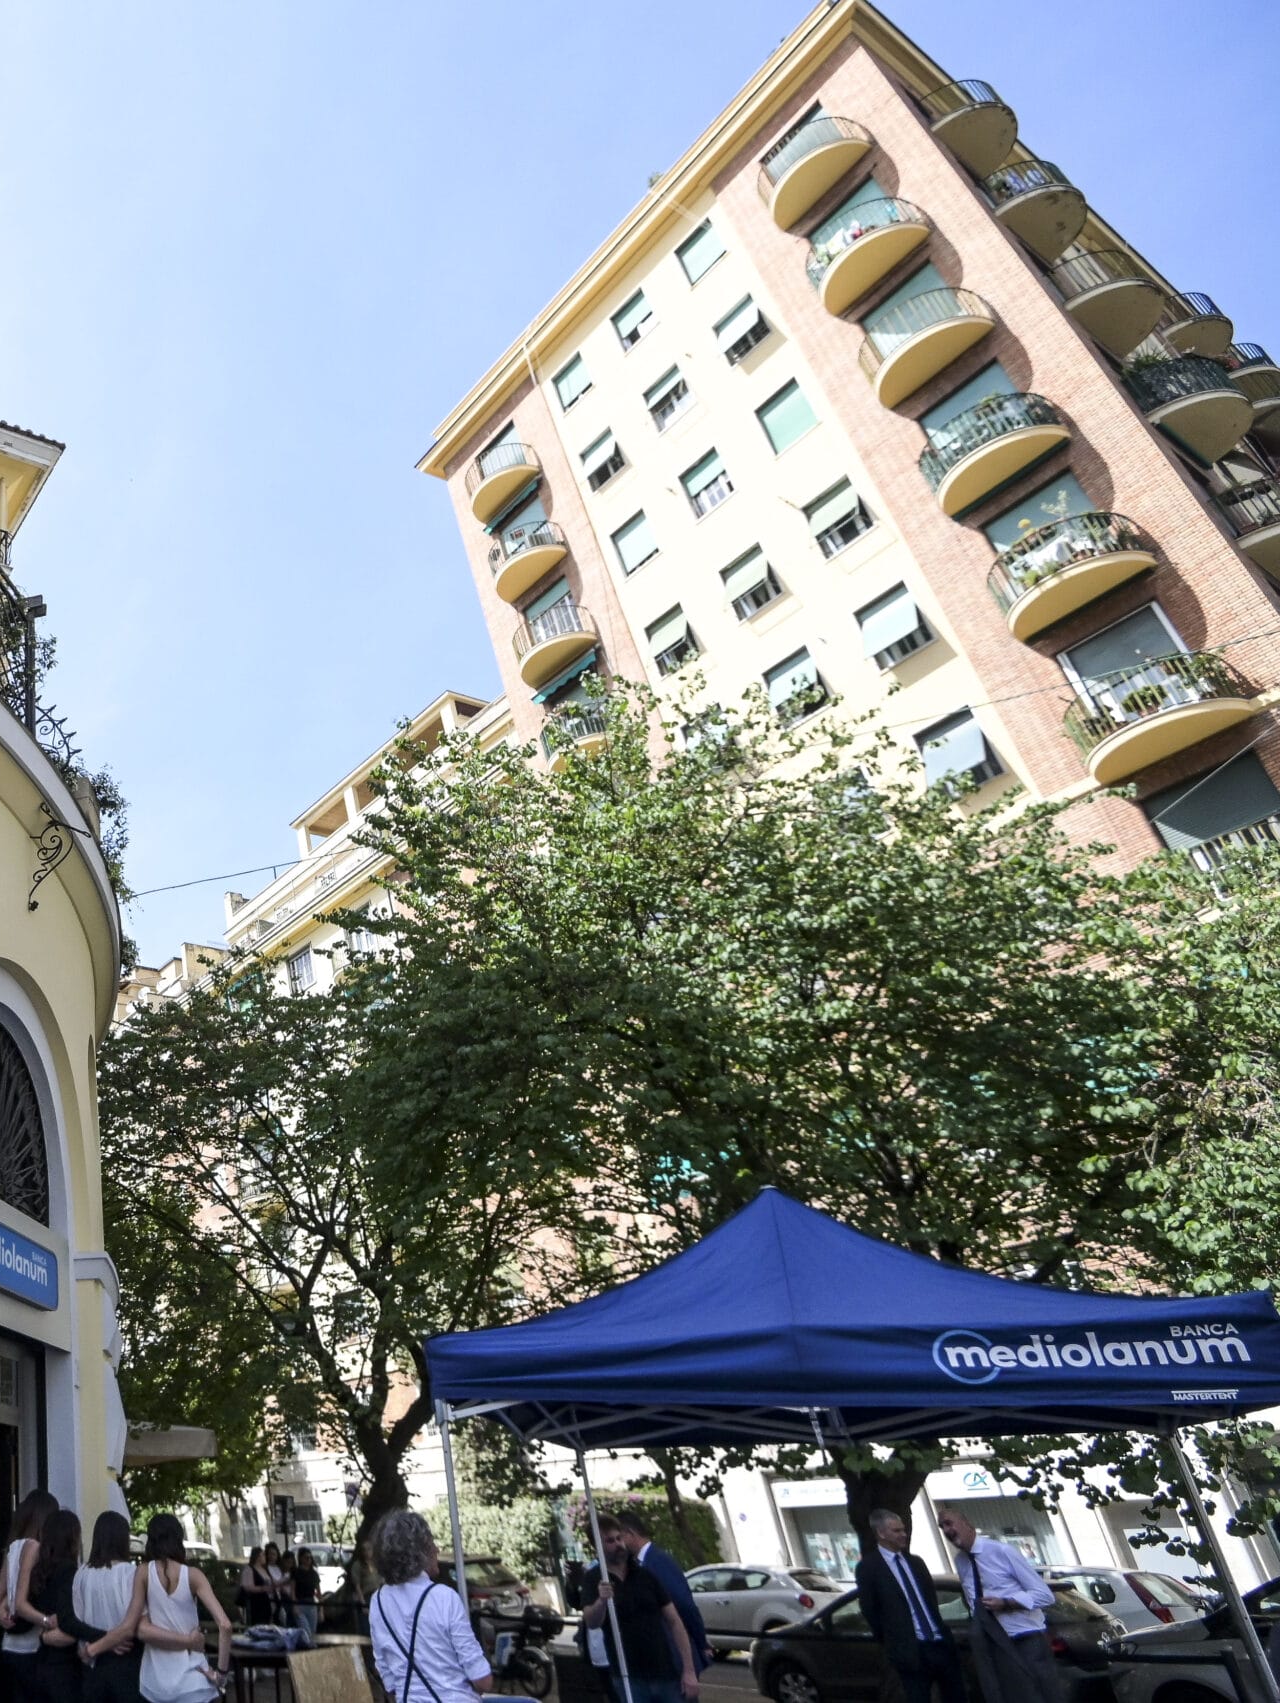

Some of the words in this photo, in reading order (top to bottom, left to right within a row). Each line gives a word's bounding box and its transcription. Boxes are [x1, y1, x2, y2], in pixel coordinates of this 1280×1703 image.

[31, 1251, 48, 1266] BANCA
[1169, 1321, 1240, 1338] BANCA
[943, 1330, 1252, 1369] mediolanum
[1173, 1392, 1238, 1401] MASTERTENT
